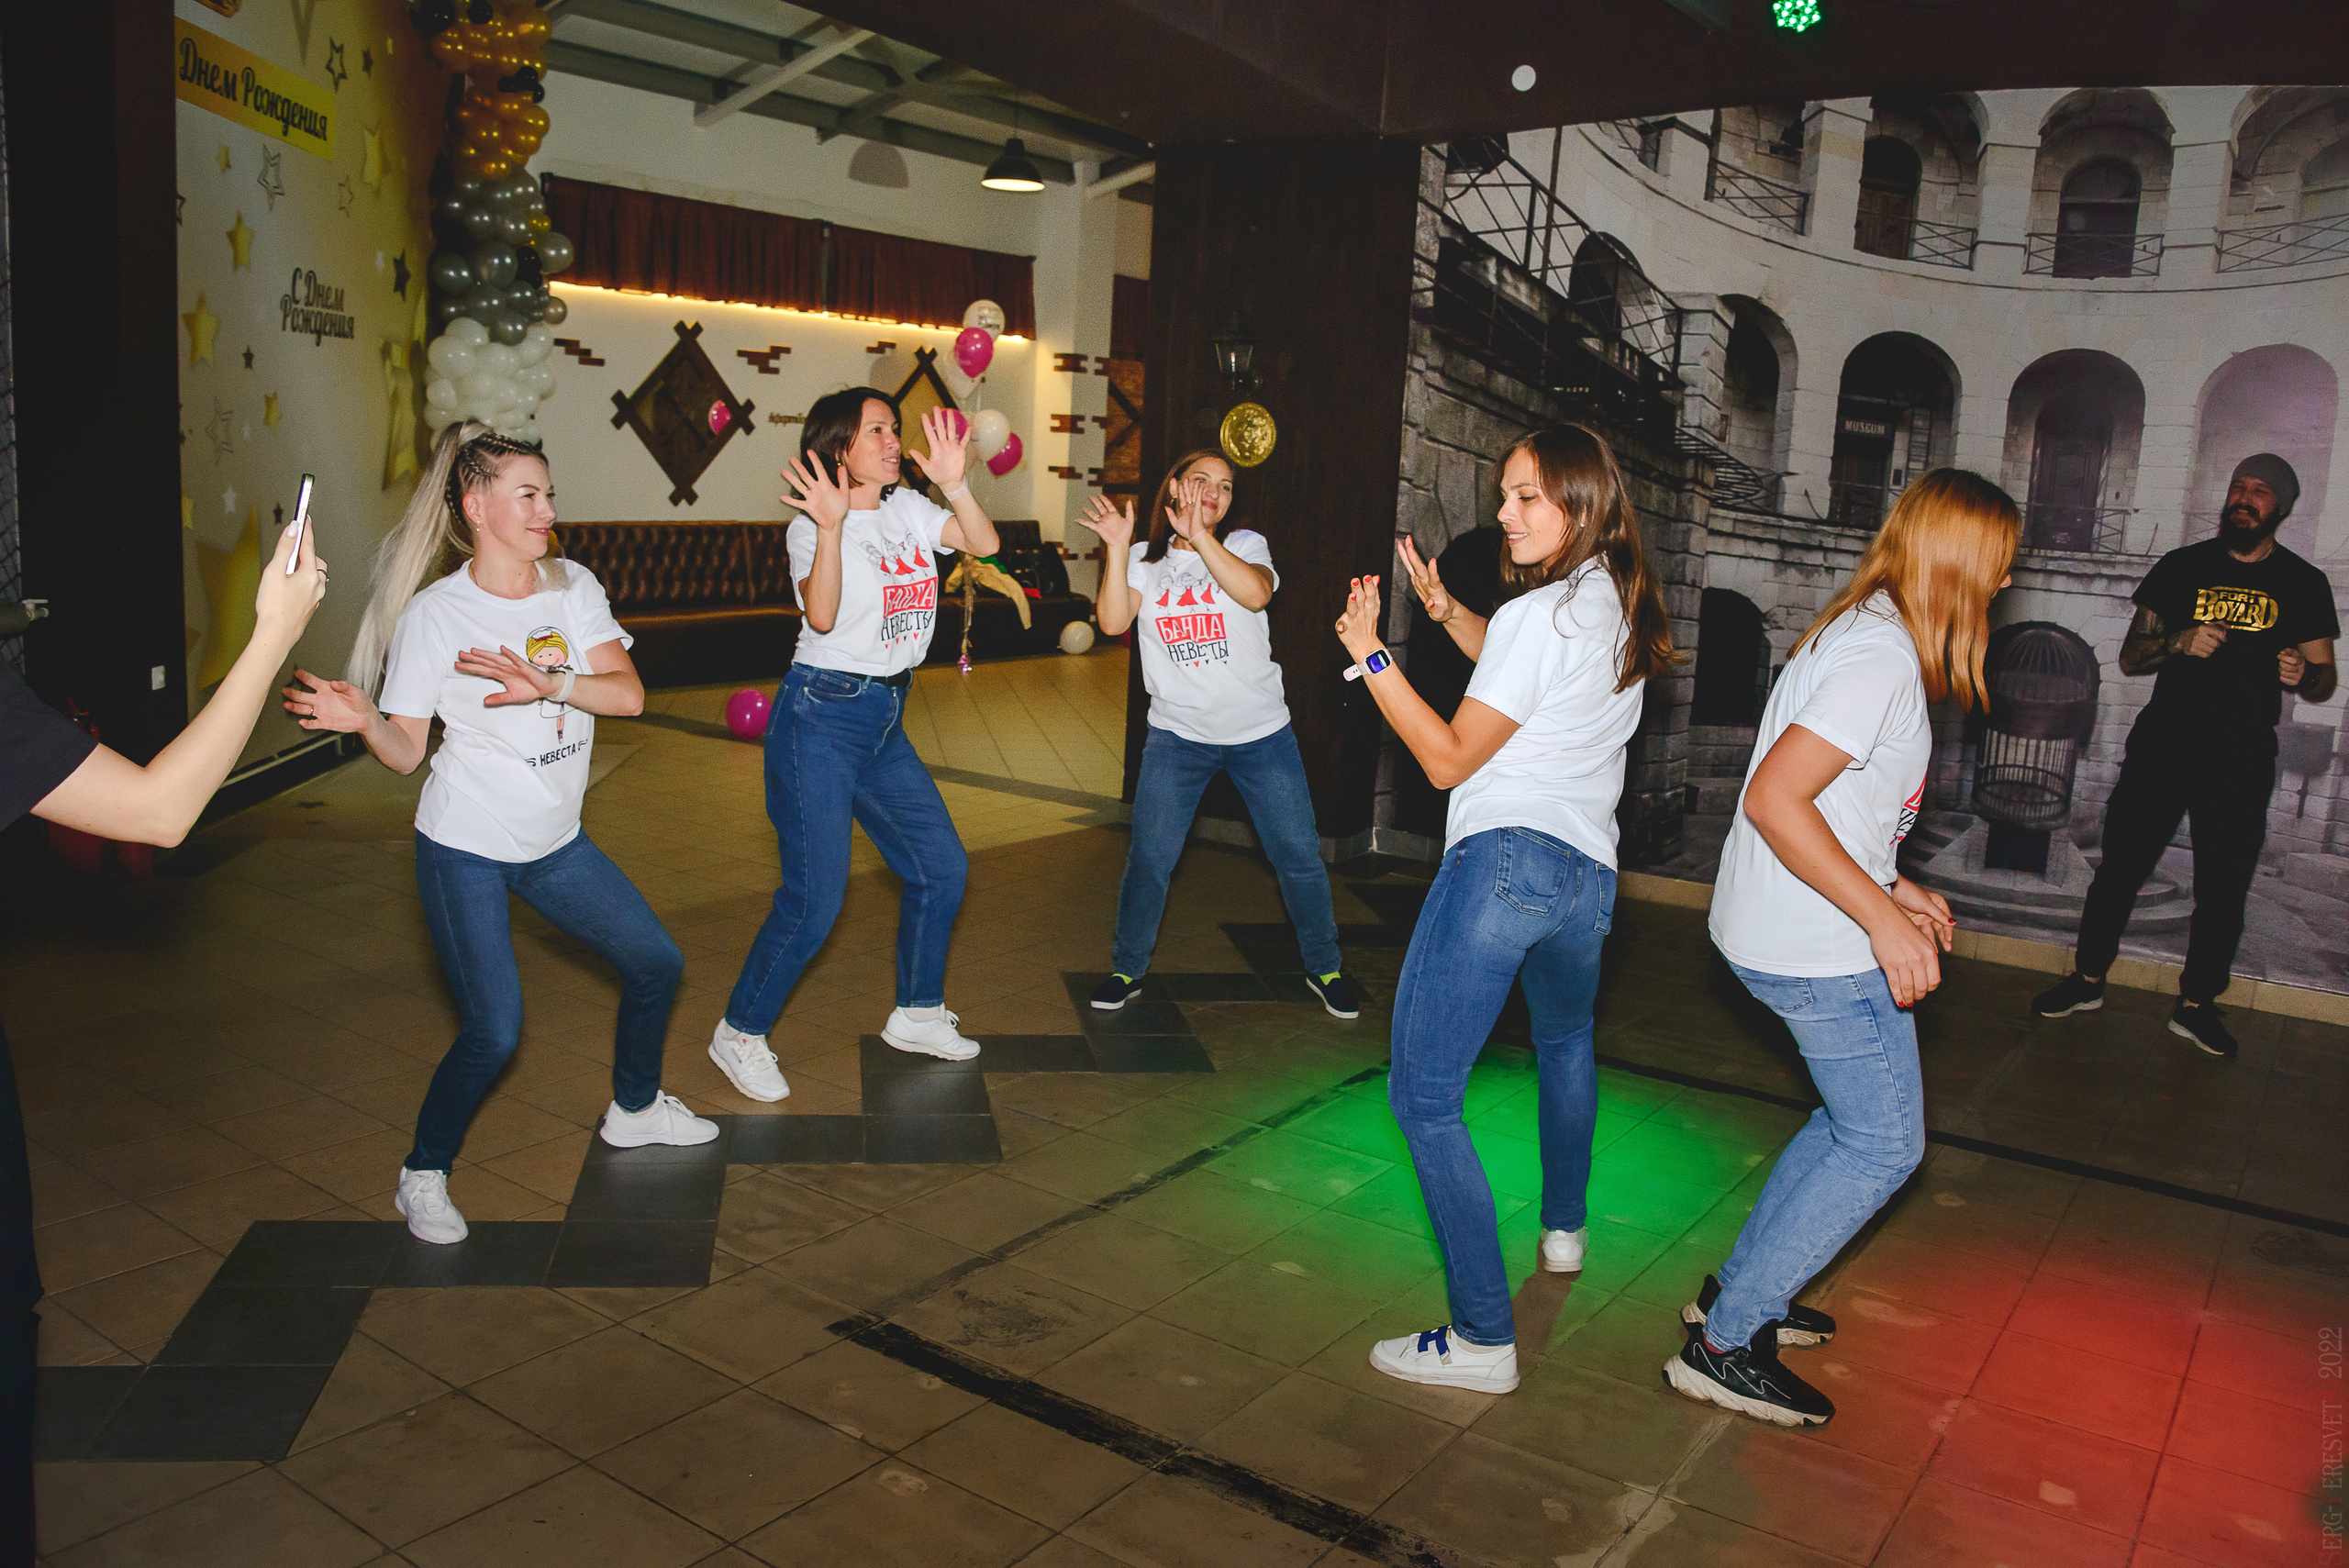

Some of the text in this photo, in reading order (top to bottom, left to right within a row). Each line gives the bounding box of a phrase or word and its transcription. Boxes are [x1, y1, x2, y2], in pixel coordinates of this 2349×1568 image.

[178, 37, 328, 141] Днем Рождения
[292, 267, 344, 312] С Днем
[280, 294, 354, 347] Рождения
[1844, 420, 1886, 435] MUSEUM
[885, 579, 936, 616] БАНДА
[2193, 588, 2279, 629] BOYARD
[2219, 592, 2256, 604] FORT
[881, 611, 935, 641] НЕВЕСТЫ
[1157, 615, 1225, 643] БАНДА
[540, 743, 577, 767] НЕВЕСТА
